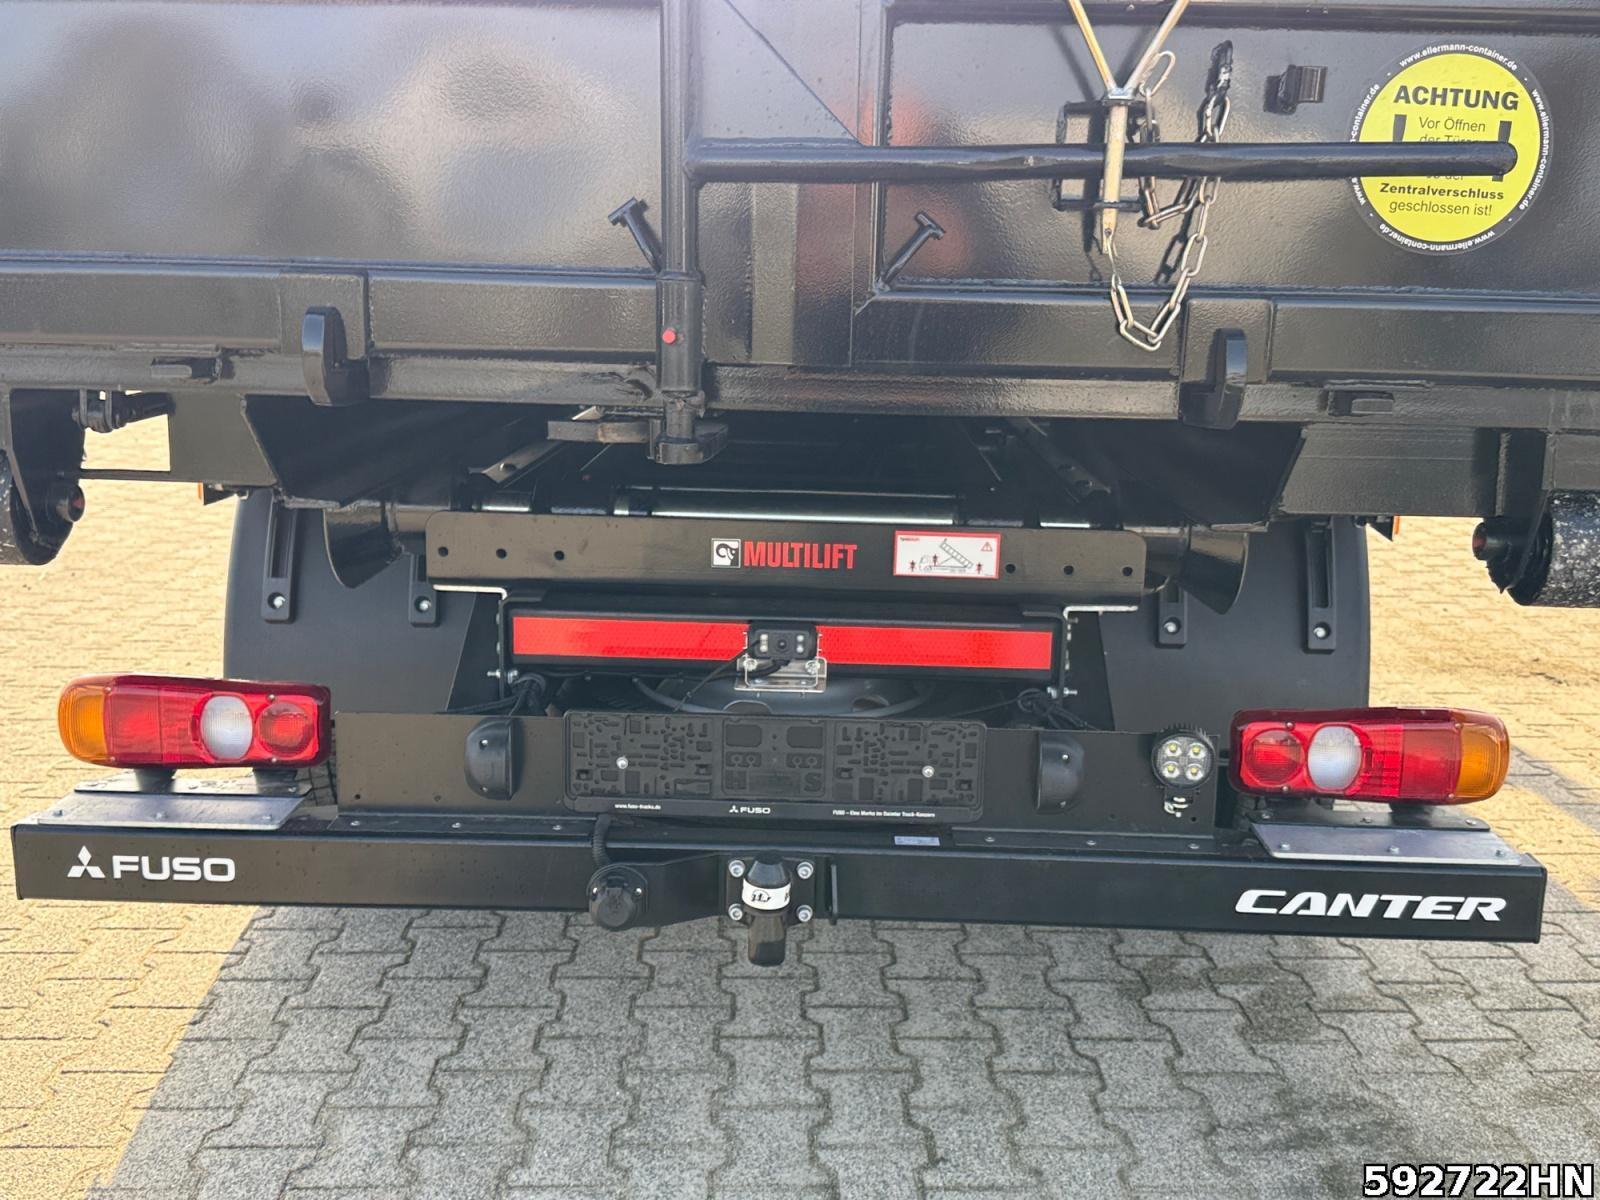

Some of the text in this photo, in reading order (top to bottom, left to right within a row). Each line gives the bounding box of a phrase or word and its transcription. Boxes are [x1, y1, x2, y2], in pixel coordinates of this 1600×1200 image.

[1399, 43, 1518, 71] www.ellermann-container.de
[1393, 85, 1519, 111] ACHTUNG
[1419, 116, 1486, 133] Vor Öffnen
[1379, 182, 1504, 200] Zentralverschluss
[1389, 200, 1493, 217] geschlossen ist!
[743, 541, 858, 569] MULTILIFT
[740, 806, 771, 814] FUSO
[112, 855, 236, 882] FUSO
[1235, 889, 1507, 921] CANTER
